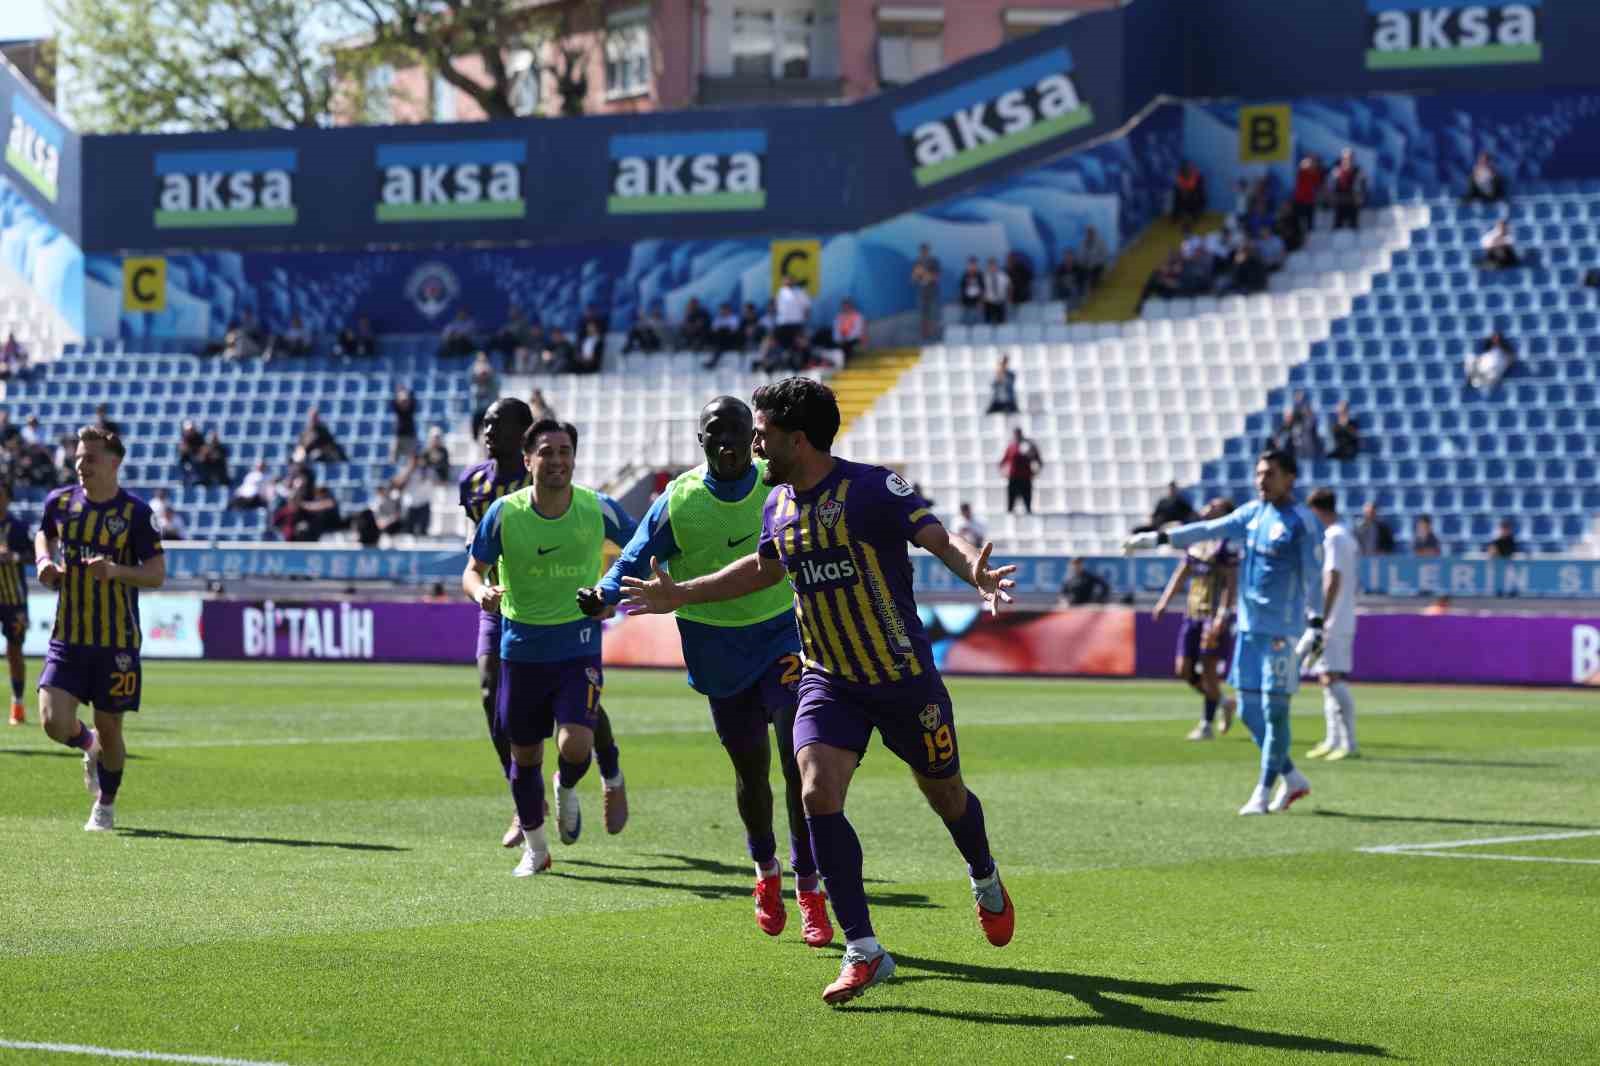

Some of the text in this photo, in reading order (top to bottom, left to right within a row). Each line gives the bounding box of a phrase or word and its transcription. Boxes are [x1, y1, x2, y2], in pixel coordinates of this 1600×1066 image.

[1373, 3, 1537, 52] aksa
[913, 73, 1082, 166] aksa
[1248, 114, 1280, 154] B
[9, 114, 60, 188] aksa
[161, 170, 293, 211] aksa
[382, 161, 521, 204] aksa
[614, 151, 761, 197] aksa
[131, 266, 157, 301] C
[779, 249, 810, 286] C
[550, 562, 587, 577] ikas
[801, 559, 855, 585] ikas
[1559, 564, 1600, 593] S
[110, 672, 137, 696] 20
[923, 724, 953, 762] 19
